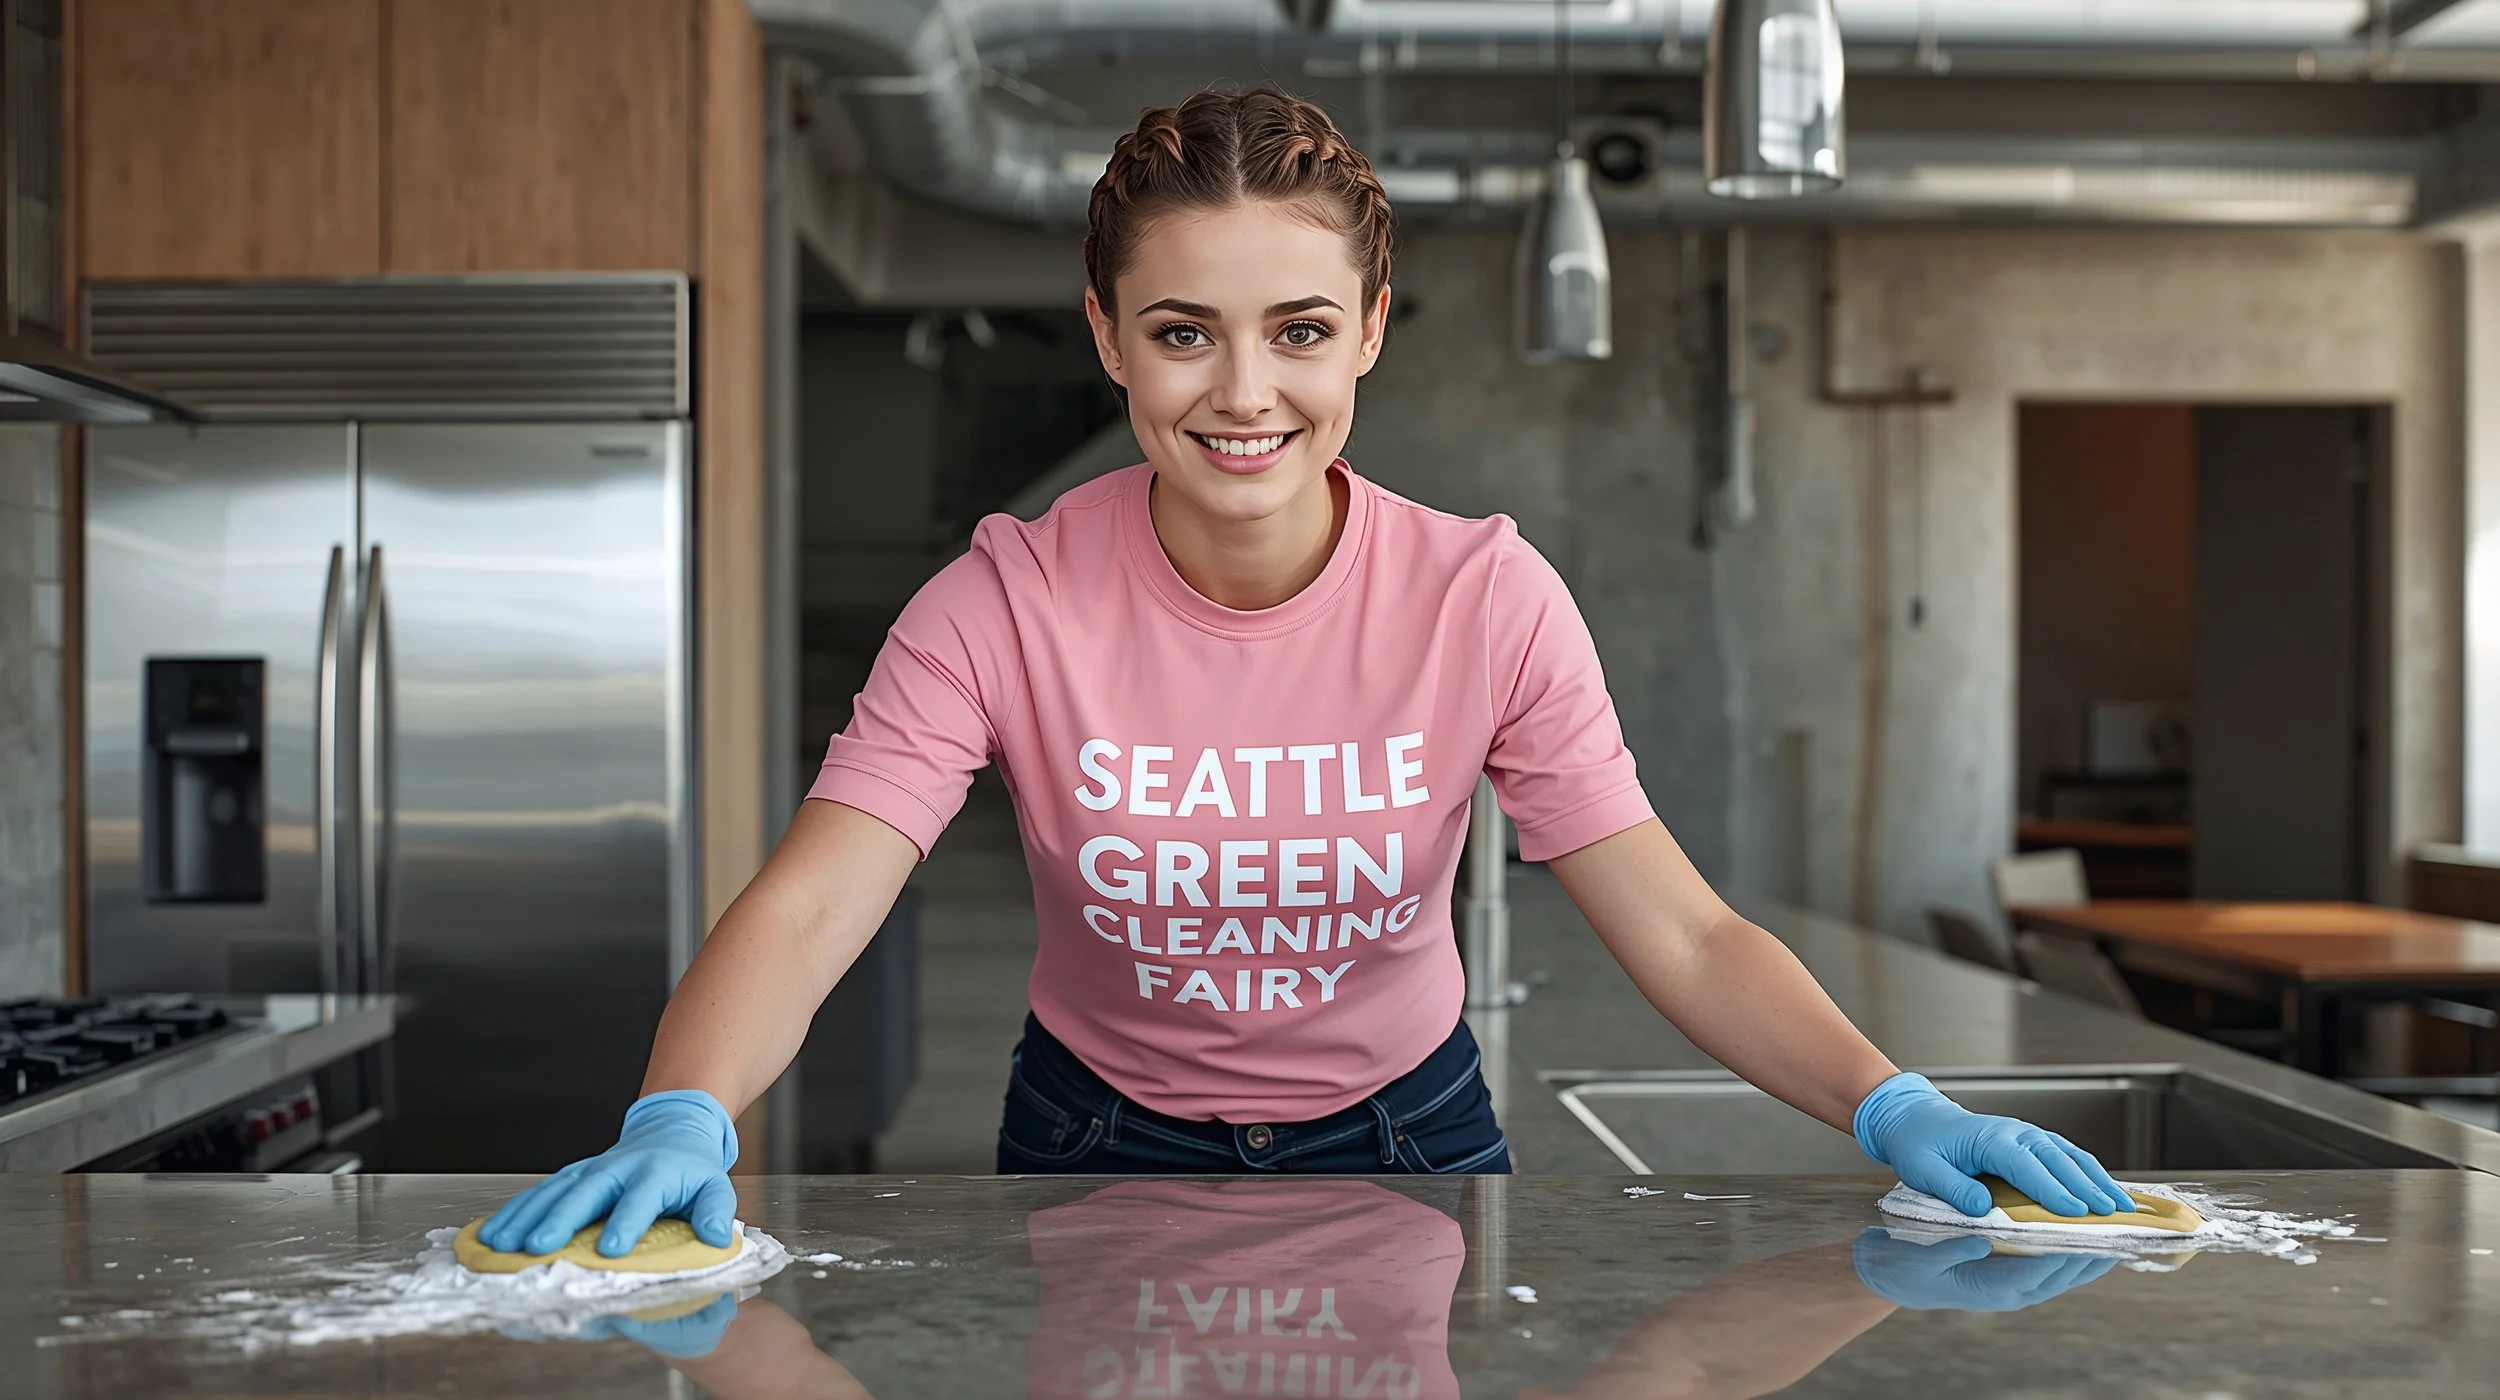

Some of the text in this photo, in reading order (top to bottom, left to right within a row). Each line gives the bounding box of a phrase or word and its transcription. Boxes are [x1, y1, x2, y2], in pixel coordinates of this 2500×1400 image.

[1073, 730, 1431, 818] SEATTLE
[1078, 831, 1403, 908] GREEN
[1082, 893, 1421, 956] CLEANING
[1134, 959, 1357, 1012] FAIRY
